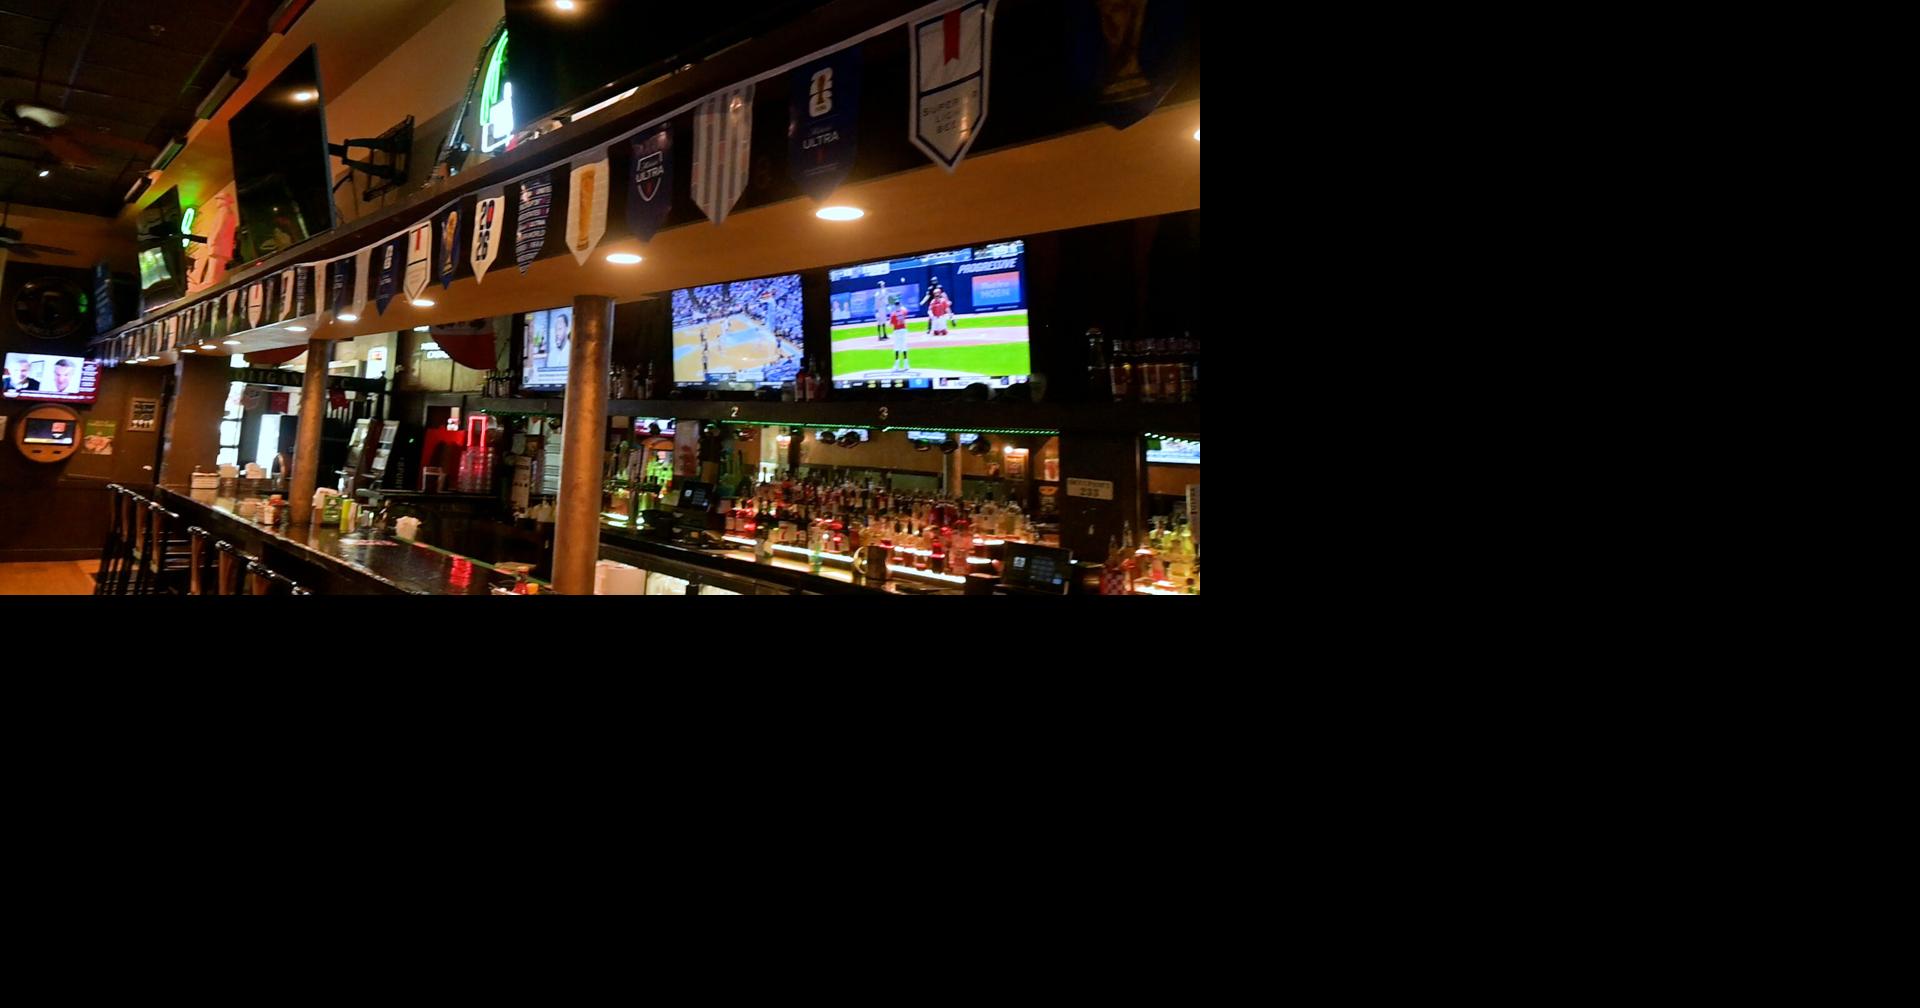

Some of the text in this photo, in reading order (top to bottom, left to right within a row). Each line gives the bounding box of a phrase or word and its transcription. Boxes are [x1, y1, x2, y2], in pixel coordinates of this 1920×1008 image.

[922, 89, 978, 117] SUPERR
[802, 130, 840, 149] ULTRA
[635, 165, 664, 183] ULTRA
[479, 199, 495, 230] 20
[476, 230, 490, 262] 26
[957, 258, 1018, 275] PROGRESSIVE
[730, 406, 739, 417] 2
[878, 406, 889, 420] 3
